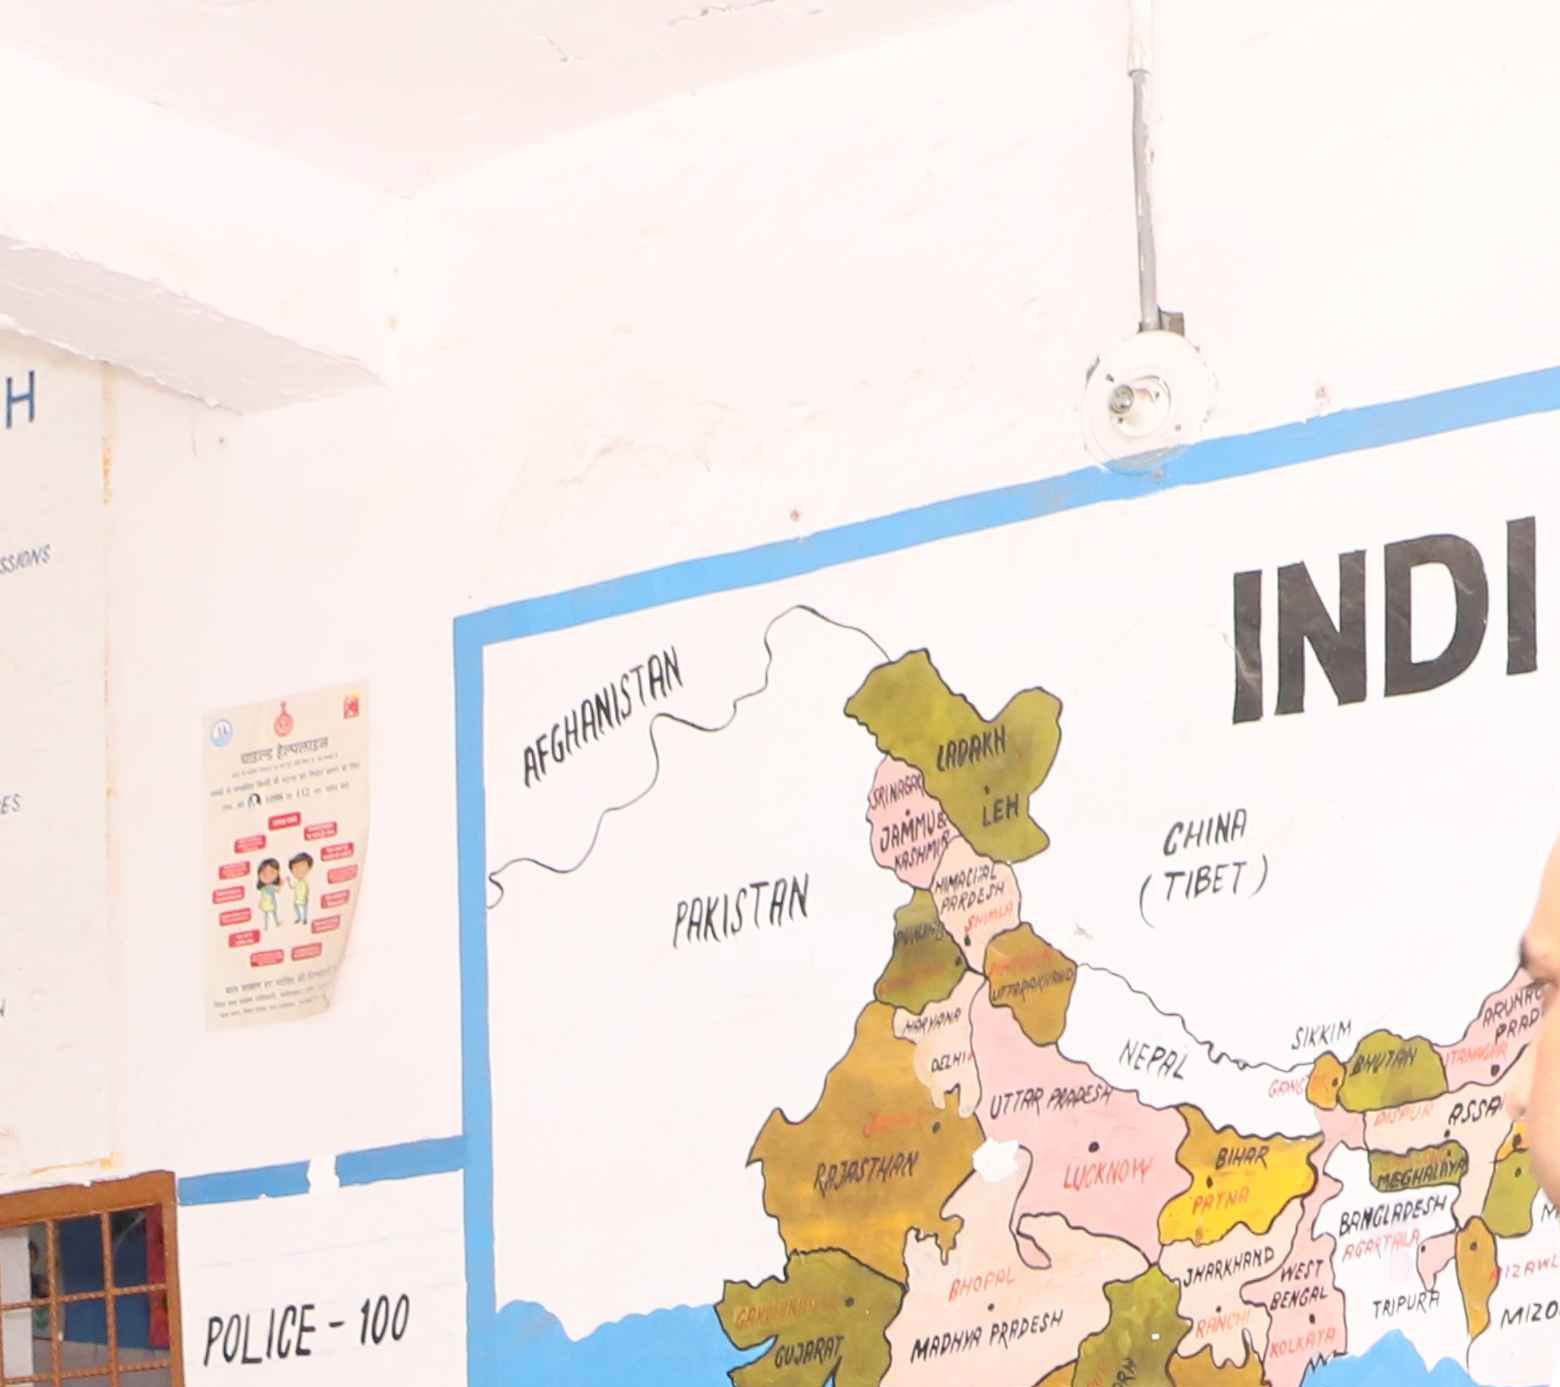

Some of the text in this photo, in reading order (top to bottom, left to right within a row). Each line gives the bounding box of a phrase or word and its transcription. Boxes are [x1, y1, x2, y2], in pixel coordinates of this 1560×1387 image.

[523, 645, 684, 789] AFGHANISTAN
[937, 725, 1007, 772] LADAKH
[982, 793, 1019, 827] LEH
[1163, 809, 1248, 856] CHINA
[672, 873, 809, 949] PAKISTAN
[1291, 1020, 1352, 1051] SIKKIM
[1119, 1039, 1189, 1081] NEPAL
[1350, 1043, 1417, 1076] BHUTAN
[990, 1085, 1114, 1121] UTTAR PRADESH
[814, 1151, 920, 1197] RAJASTHAN
[1064, 1156, 1154, 1191] LUCKNOW
[1215, 1145, 1270, 1171] BIHAR
[1192, 1186, 1250, 1216] PATNA
[1339, 1195, 1447, 1238] BANGLADESH
[948, 1266, 1016, 1303] BHOPAL
[1183, 1246, 1275, 1288] JHARKHAND
[1280, 1258, 1323, 1283] WEST
[1269, 1285, 1329, 1312] BENGAL
[1371, 1290, 1440, 1321] TRIPURA
[204, 1303, 316, 1367] POLICE
[360, 1293, 410, 1347] 100
[910, 1309, 1065, 1365] MADHYA PRADESH
[1195, 1310, 1251, 1341] RANCHI
[775, 1336, 845, 1369] GUJARAT
[1268, 1328, 1337, 1359] KOLKATA
